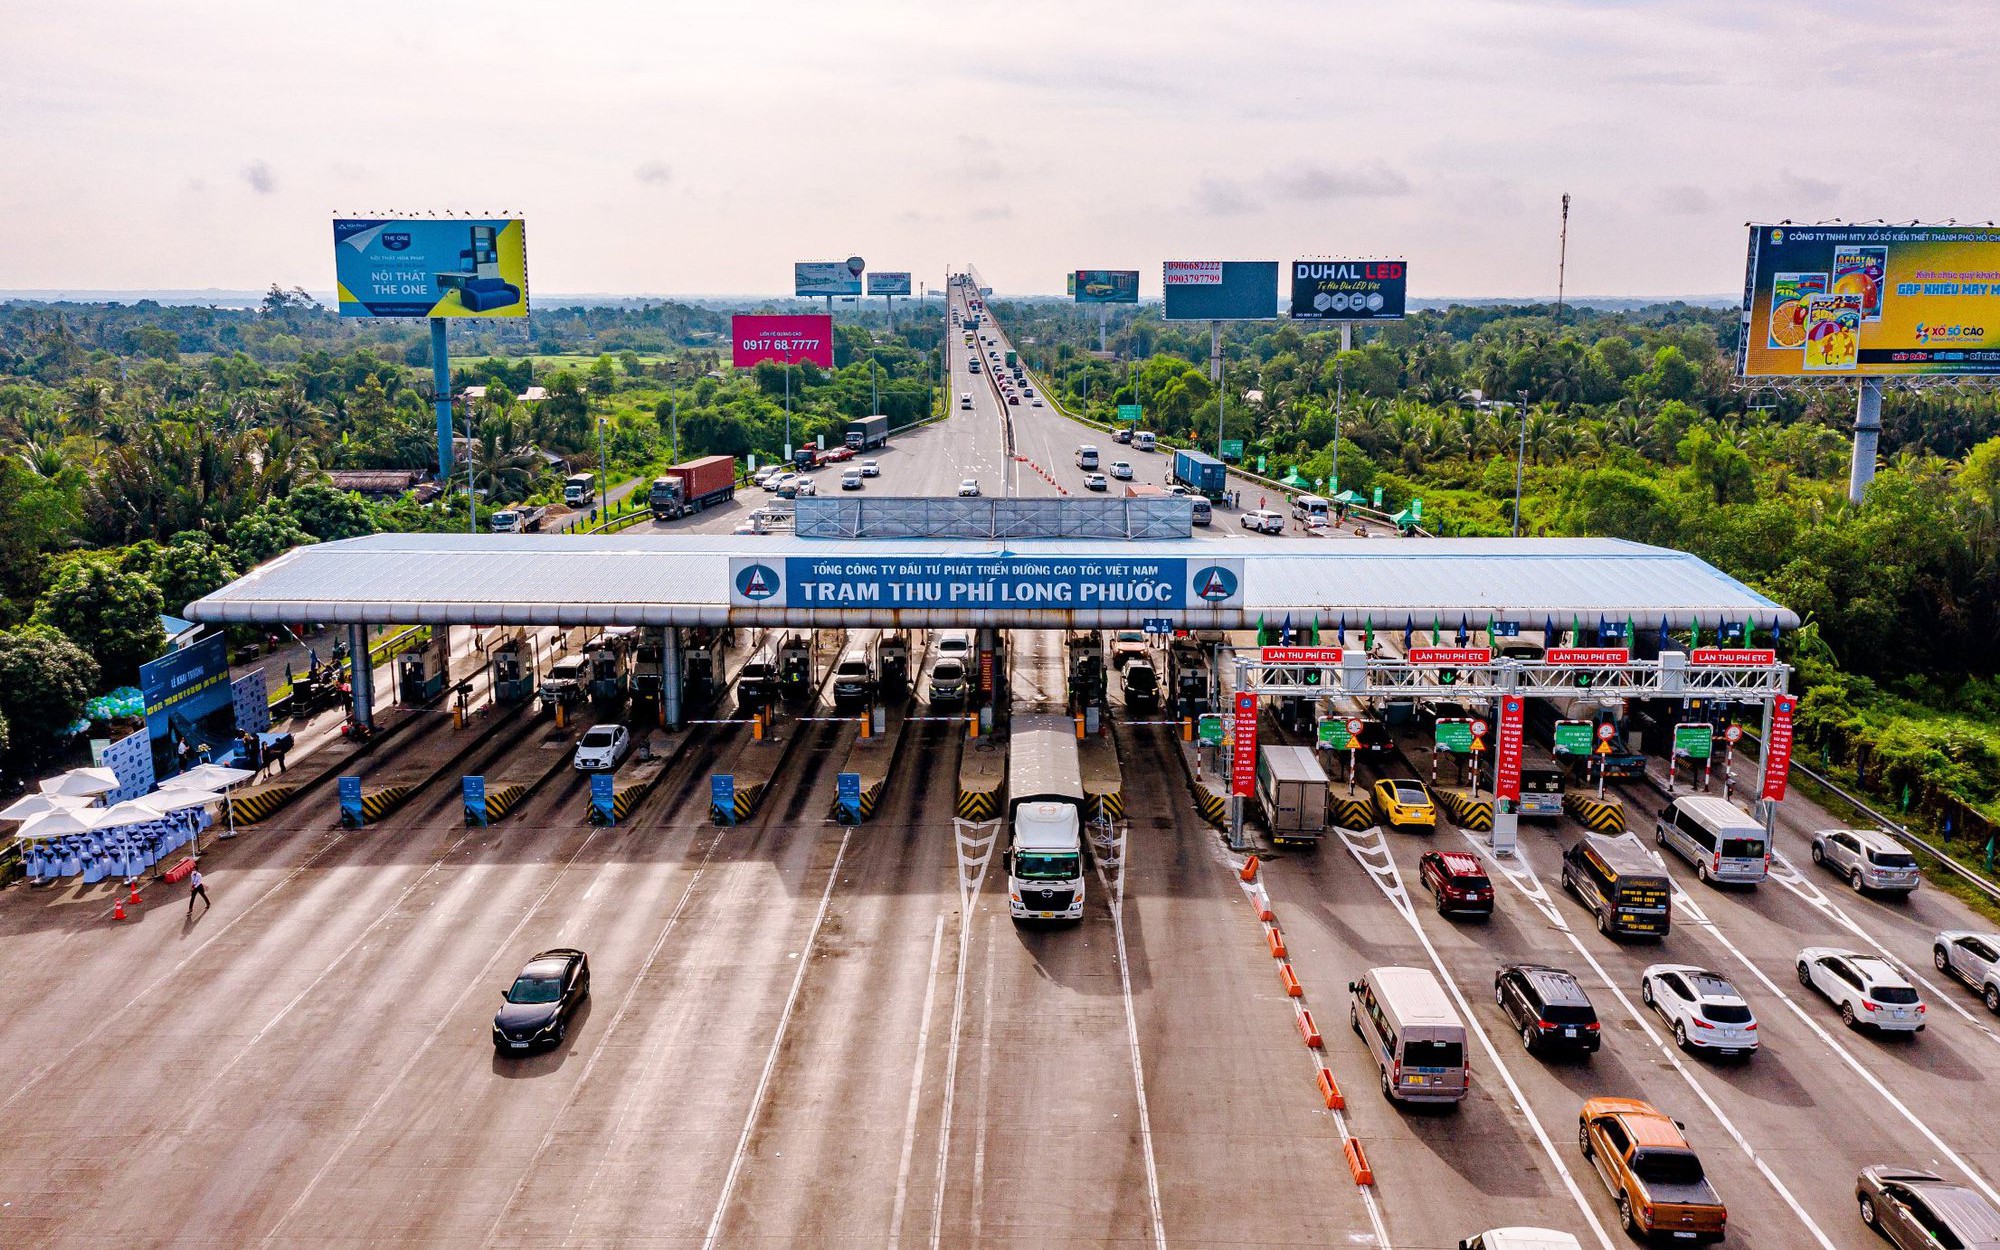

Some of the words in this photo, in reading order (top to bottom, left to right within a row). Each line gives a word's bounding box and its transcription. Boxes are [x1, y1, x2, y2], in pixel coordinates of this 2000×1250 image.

[1789, 232, 1814, 242] CÔNG
[1816, 233, 1825, 241] TY
[1826, 233, 1847, 241] TNHH
[1850, 233, 1866, 241] MTV
[1867, 230, 1878, 241] XỔ
[1880, 230, 1891, 241] SỐ
[1892, 230, 1909, 241] KIẾN
[1911, 230, 1929, 241] THIẾT
[1932, 231, 1956, 242] THÀNH
[1958, 230, 1974, 242] PHỐ
[1976, 230, 1988, 242] HỒ
[1168, 262, 1220, 270] 0906682222
[372, 269, 393, 284] NỘI
[395, 269, 426, 281] THẤT
[1297, 264, 1360, 279] DUHAL
[1365, 264, 1402, 279] LED
[1168, 274, 1220, 284] 0903797799
[373, 284, 397, 294] THE
[401, 284, 428, 294] ONE
[1352, 281, 1367, 290] LED
[1932, 324, 1946, 336] XỔ
[1947, 324, 1960, 336] SỐ
[743, 340, 771, 350] 0917
[774, 340, 788, 350] 68
[791, 340, 820, 350] 7777
[812, 560, 842, 575] TỔNG
[846, 562, 878, 575] CÔNG
[881, 564, 896, 575] TY
[900, 561, 922, 575] ĐẦU
[926, 563, 942, 575] TƯ
[944, 562, 973, 576] PHÁT
[977, 560, 1008, 576] TRIỂN
[1012, 562, 1050, 576] ĐƯỜNG
[1054, 565, 1076, 576] CAO
[1080, 562, 1104, 576] TỐC
[1105, 562, 1129, 578] VIỆT
[1132, 565, 1158, 576] NAM
[800, 582, 880, 605] TRẠM
[888, 582, 943, 601] THU
[950, 578, 995, 602] PHÍ
[1001, 582, 1072, 602] LONG
[1080, 578, 1172, 602] PHƯỚC
[1268, 650, 1286, 660] LÀN
[1306, 651, 1320, 660] PHÍ
[1416, 652, 1433, 660] LÀN
[1453, 652, 1468, 660] PHÍ
[1554, 652, 1570, 660] LÀN
[1590, 652, 1605, 661] PHÍ
[1699, 652, 1716, 662] LÀN
[1736, 653, 1751, 662] PHÍ
